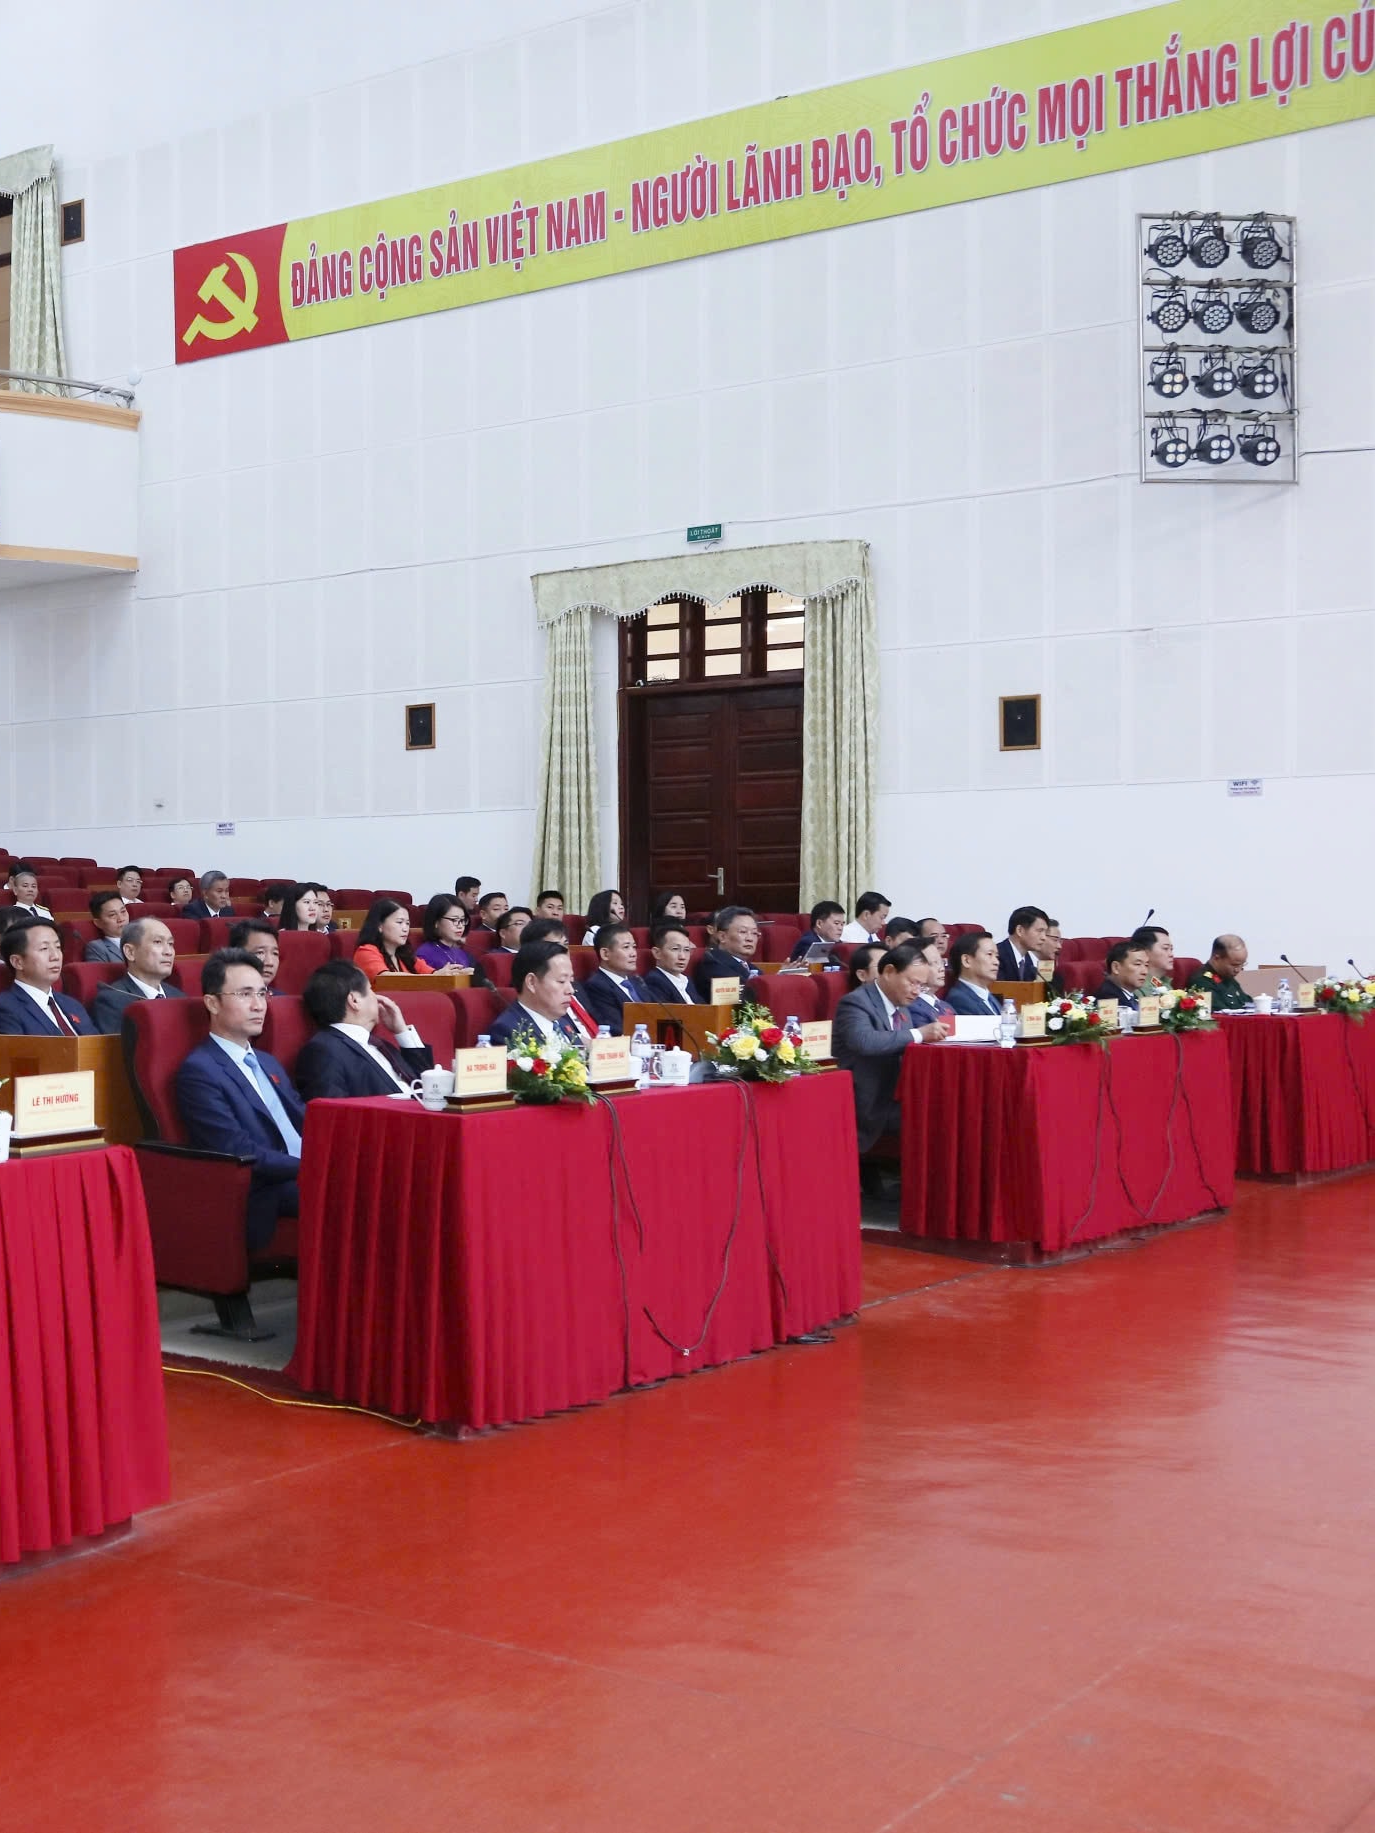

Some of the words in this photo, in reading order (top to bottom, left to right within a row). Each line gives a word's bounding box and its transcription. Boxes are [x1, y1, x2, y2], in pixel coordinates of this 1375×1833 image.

[291, 242, 353, 308] ĐẢNG
[359, 232, 423, 300] CỘNG
[429, 209, 480, 279] SẢN
[485, 200, 540, 272] VIỆT
[546, 190, 607, 252] NAM
[631, 153, 718, 233] NGƯỜI
[726, 143, 803, 212] LÃNH
[811, 127, 882, 200] ĐẠO,
[890, 91, 931, 176] TỔ
[938, 85, 1027, 166] CHỨC
[1038, 74, 1105, 151] MỌI
[1114, 32, 1238, 128] THẮNG
[1249, 21, 1310, 106] LỢI
